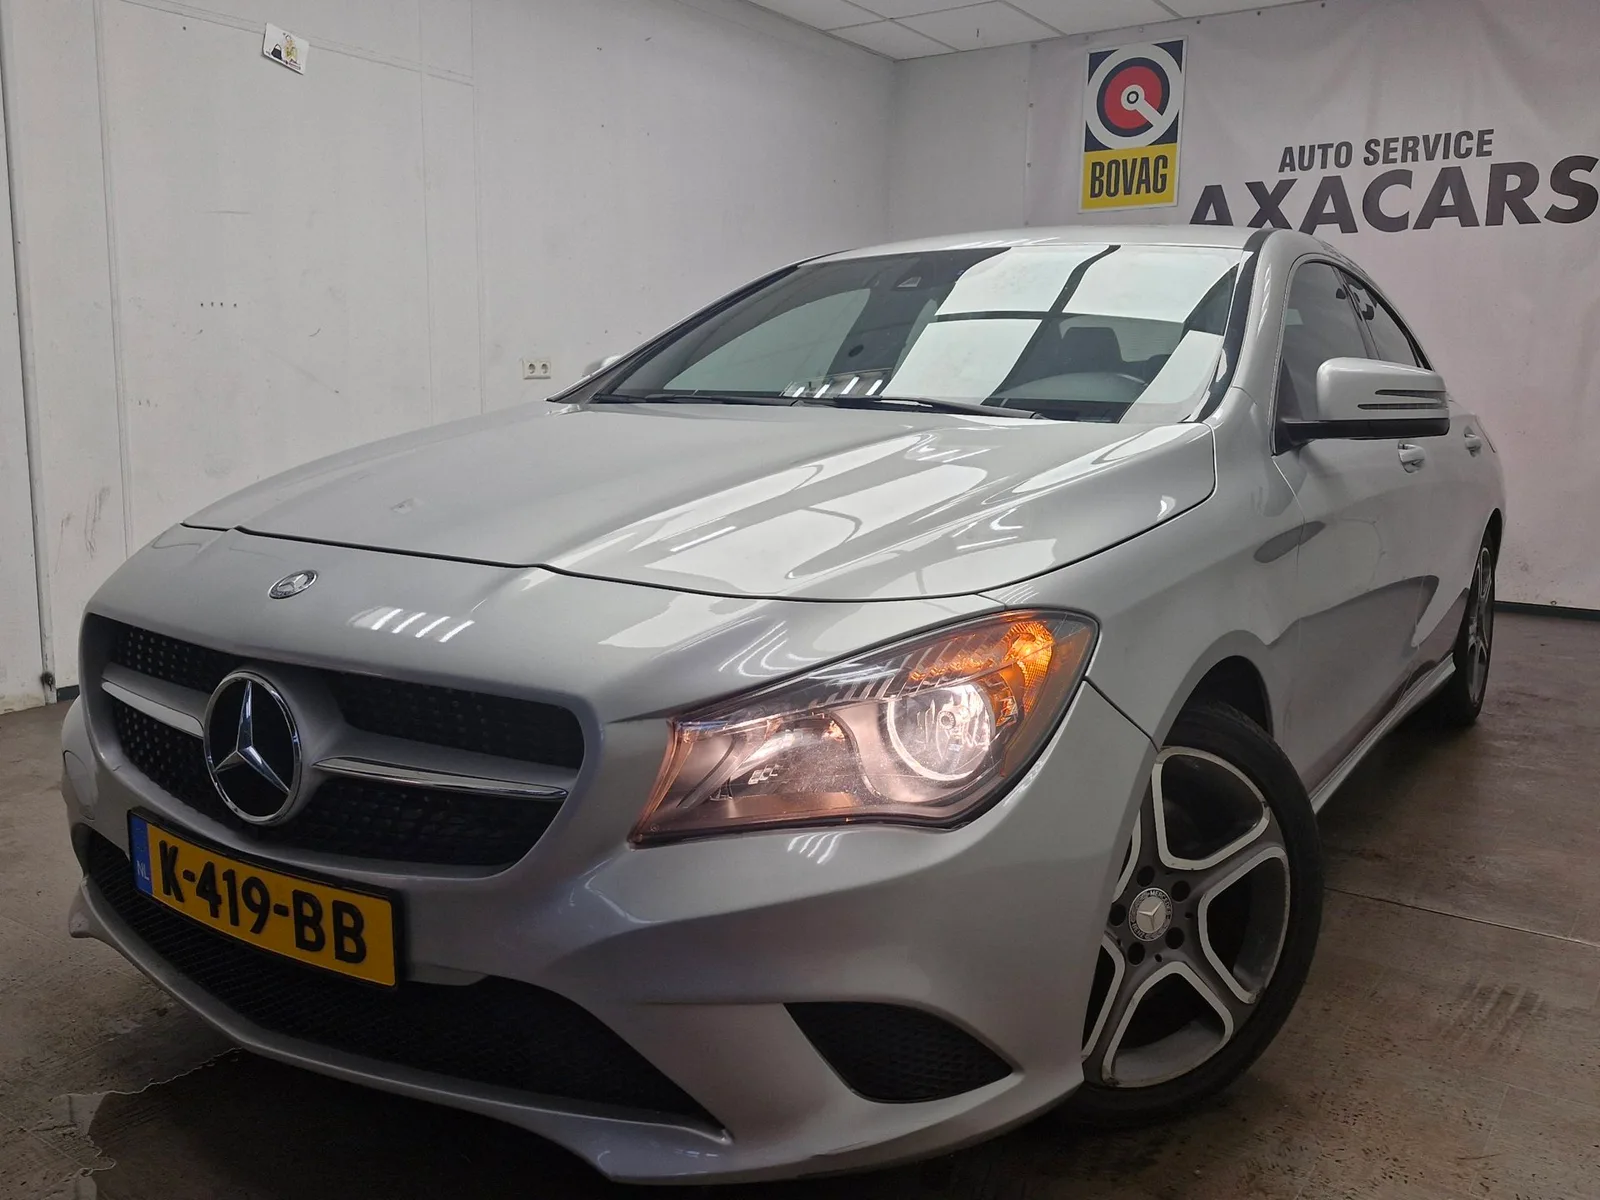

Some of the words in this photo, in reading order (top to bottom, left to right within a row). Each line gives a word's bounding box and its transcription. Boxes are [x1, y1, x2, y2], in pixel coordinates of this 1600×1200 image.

[1278, 141, 1353, 172] AUTO
[1363, 128, 1495, 165] SERVICE
[1090, 154, 1168, 198] BOVAG
[1189, 155, 1600, 235] AXACARS
[136, 860, 150, 881] NL
[159, 840, 367, 964] K-419-BB
